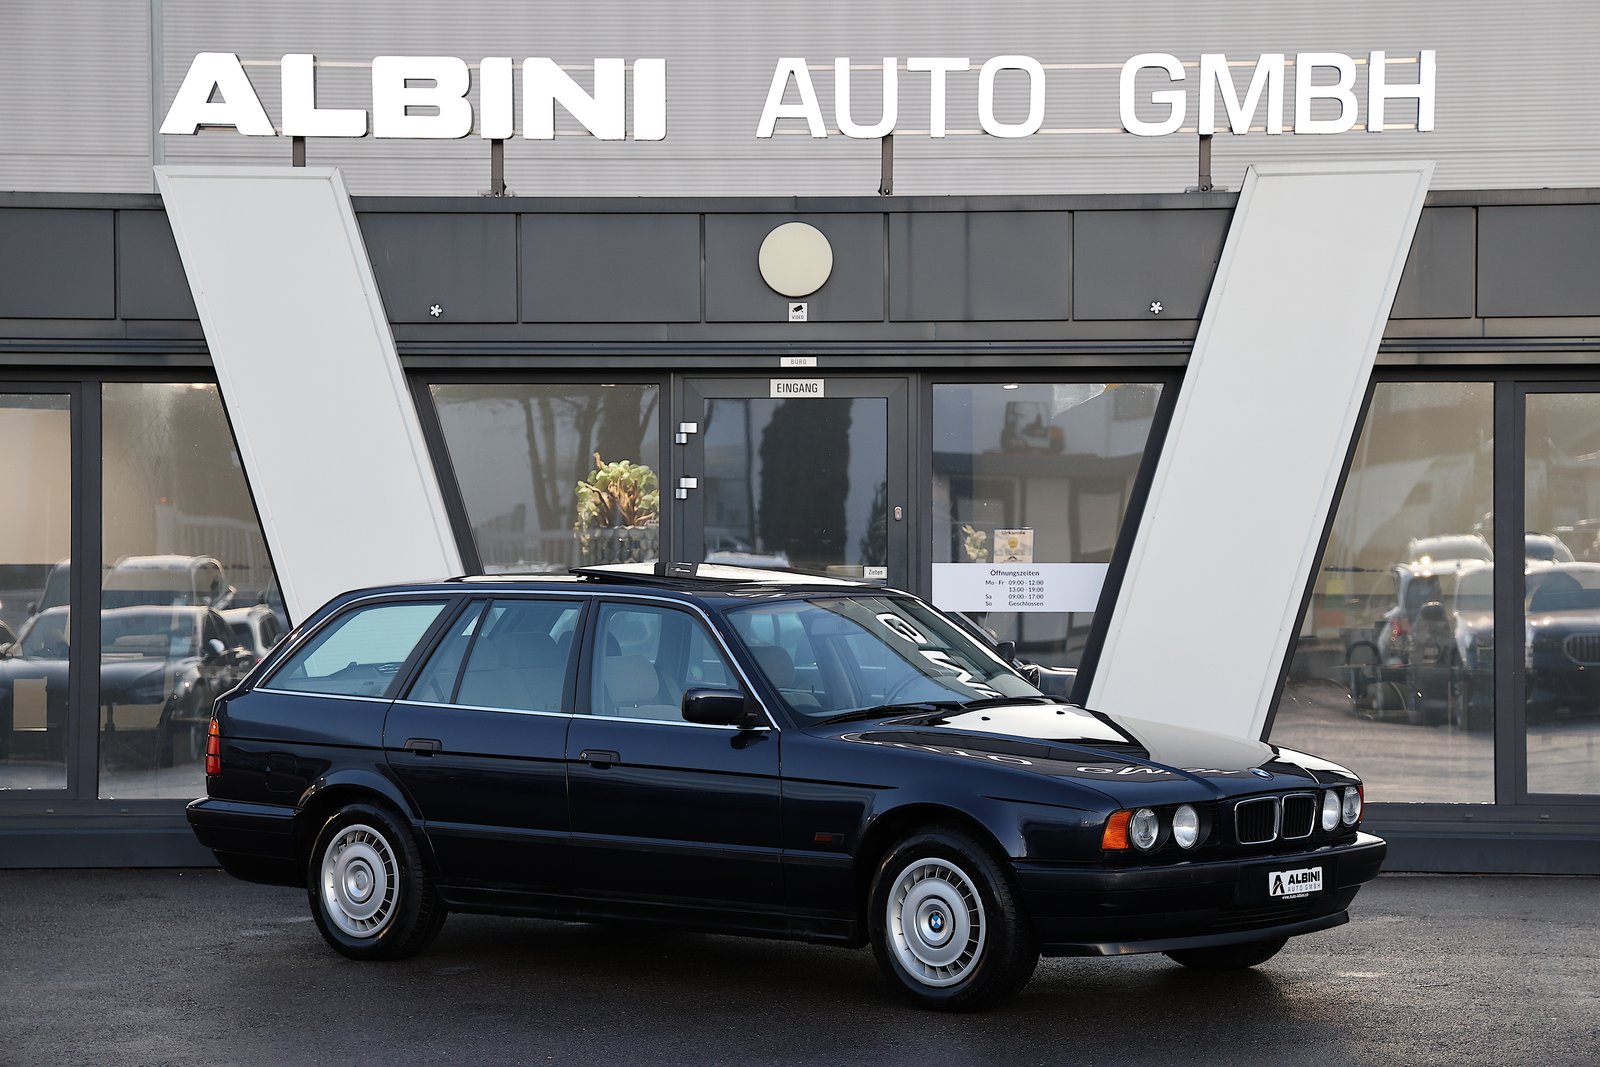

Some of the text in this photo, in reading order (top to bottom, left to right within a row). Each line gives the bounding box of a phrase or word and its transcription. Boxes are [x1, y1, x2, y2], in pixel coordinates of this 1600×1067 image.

[159, 49, 1437, 141] ALBINI AUTO GMBH
[777, 383, 818, 393] EINGANG
[1288, 871, 1320, 885] ALBINI
[1288, 884, 1303, 892] AUTO
